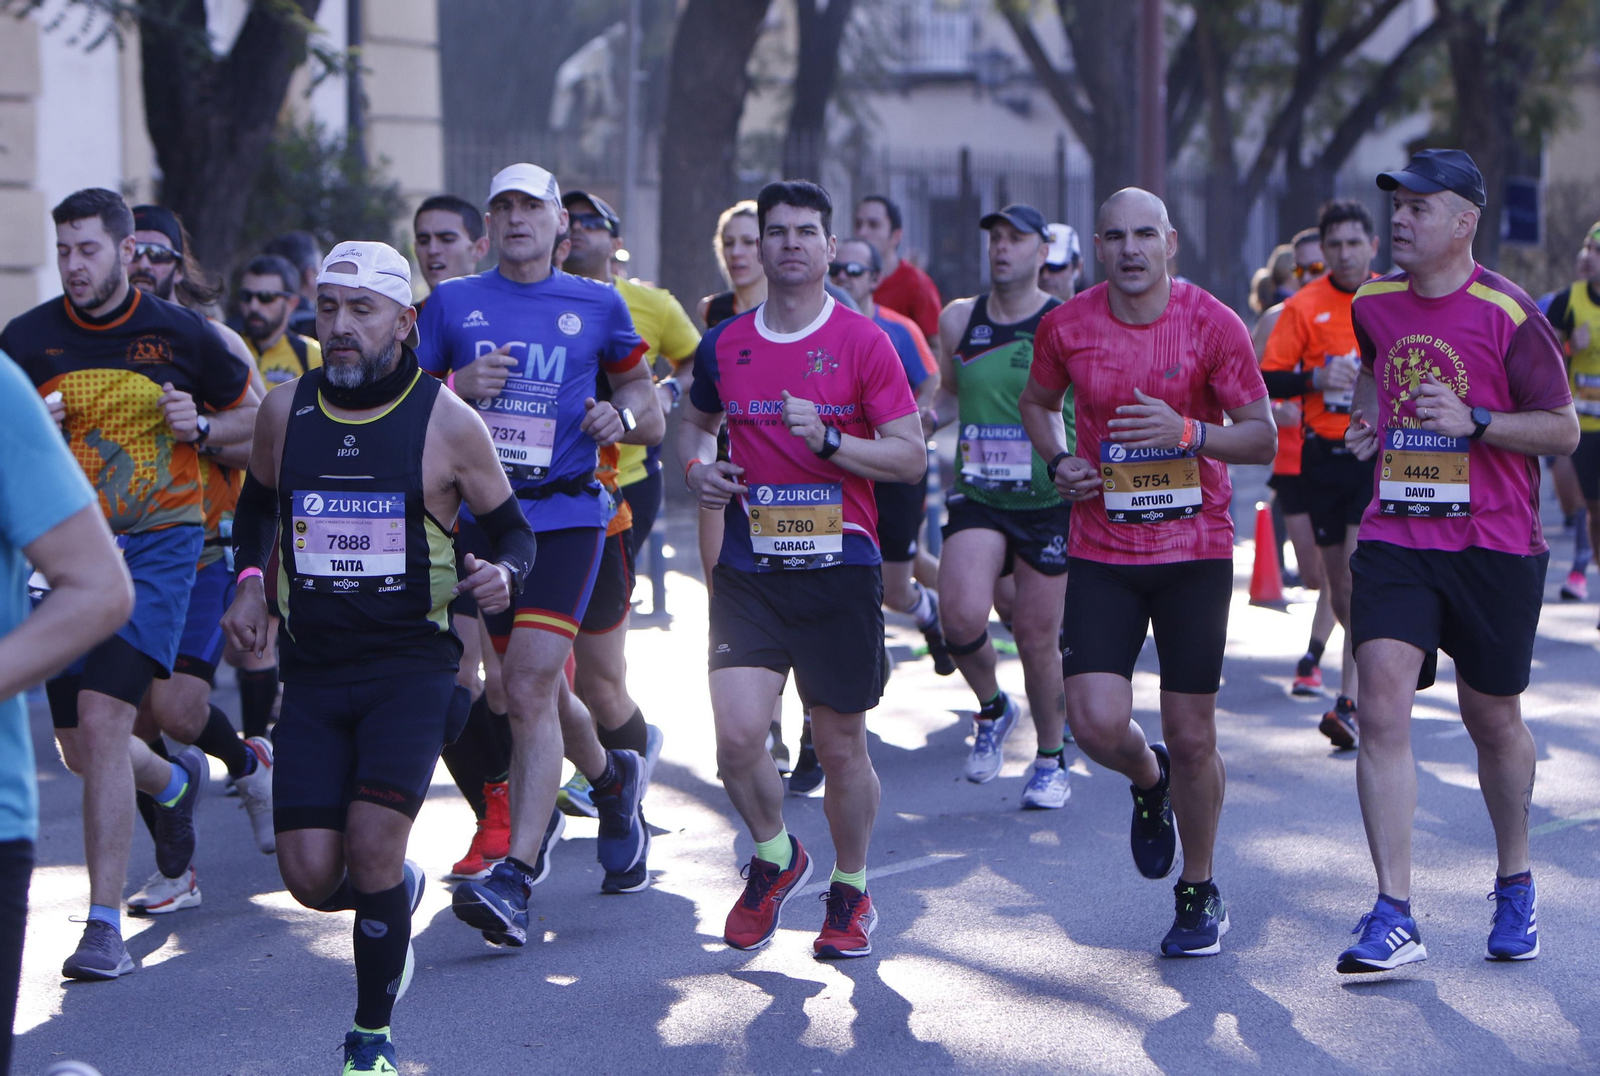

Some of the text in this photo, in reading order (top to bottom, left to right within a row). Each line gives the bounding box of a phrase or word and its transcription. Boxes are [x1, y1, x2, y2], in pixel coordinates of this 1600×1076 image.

[1388, 334, 1433, 363] ATLETISMO
[1433, 338, 1470, 398] BENACAZÓN
[494, 398, 547, 414] ZURICH
[748, 400, 784, 414] BNK
[814, 403, 855, 416] nners
[492, 426, 526, 442] 7374
[980, 427, 1021, 438] ZURICH
[1406, 435, 1457, 448] ZURICH
[1404, 465, 1440, 479] 4442
[1133, 473, 1170, 488] 5754
[776, 489, 830, 501] ZURICH
[1405, 487, 1435, 498] DAVID
[327, 499, 390, 513] ZURICH
[1131, 494, 1173, 506] ARTURO
[777, 519, 814, 533] 5780
[327, 534, 371, 550] 7888
[774, 540, 816, 551] CARACA
[330, 559, 364, 572] TAITA
[378, 585, 402, 593] ZURICH
